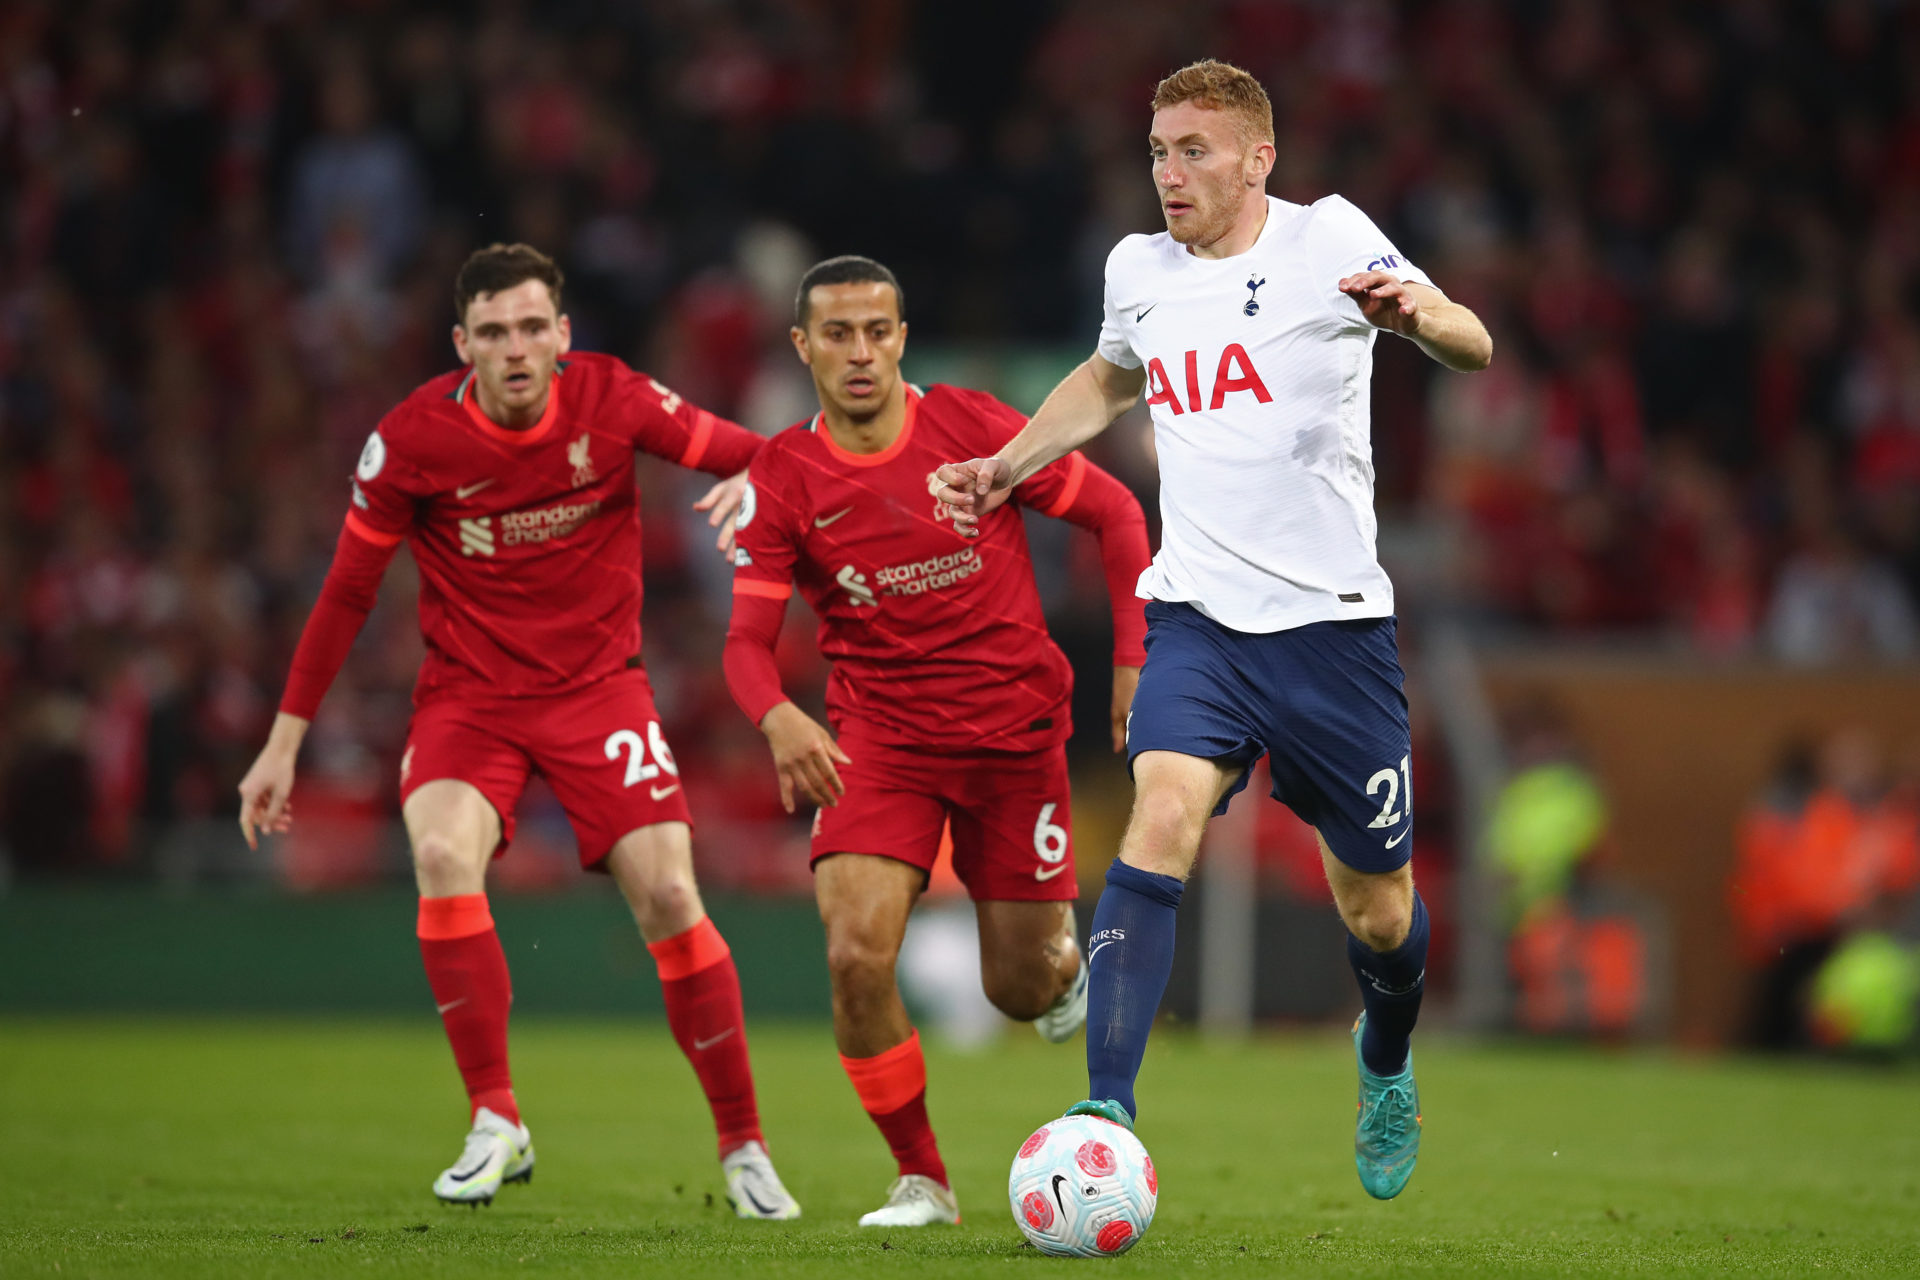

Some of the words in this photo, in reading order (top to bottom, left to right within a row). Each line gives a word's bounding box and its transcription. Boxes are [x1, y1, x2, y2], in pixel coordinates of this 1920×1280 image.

[1146, 342, 1274, 416] AIA
[875, 546, 974, 585] standard
[604, 720, 679, 788] 26
[1366, 754, 1411, 828] 21
[1033, 802, 1067, 863] 6
[1089, 928, 1126, 949] PURS
